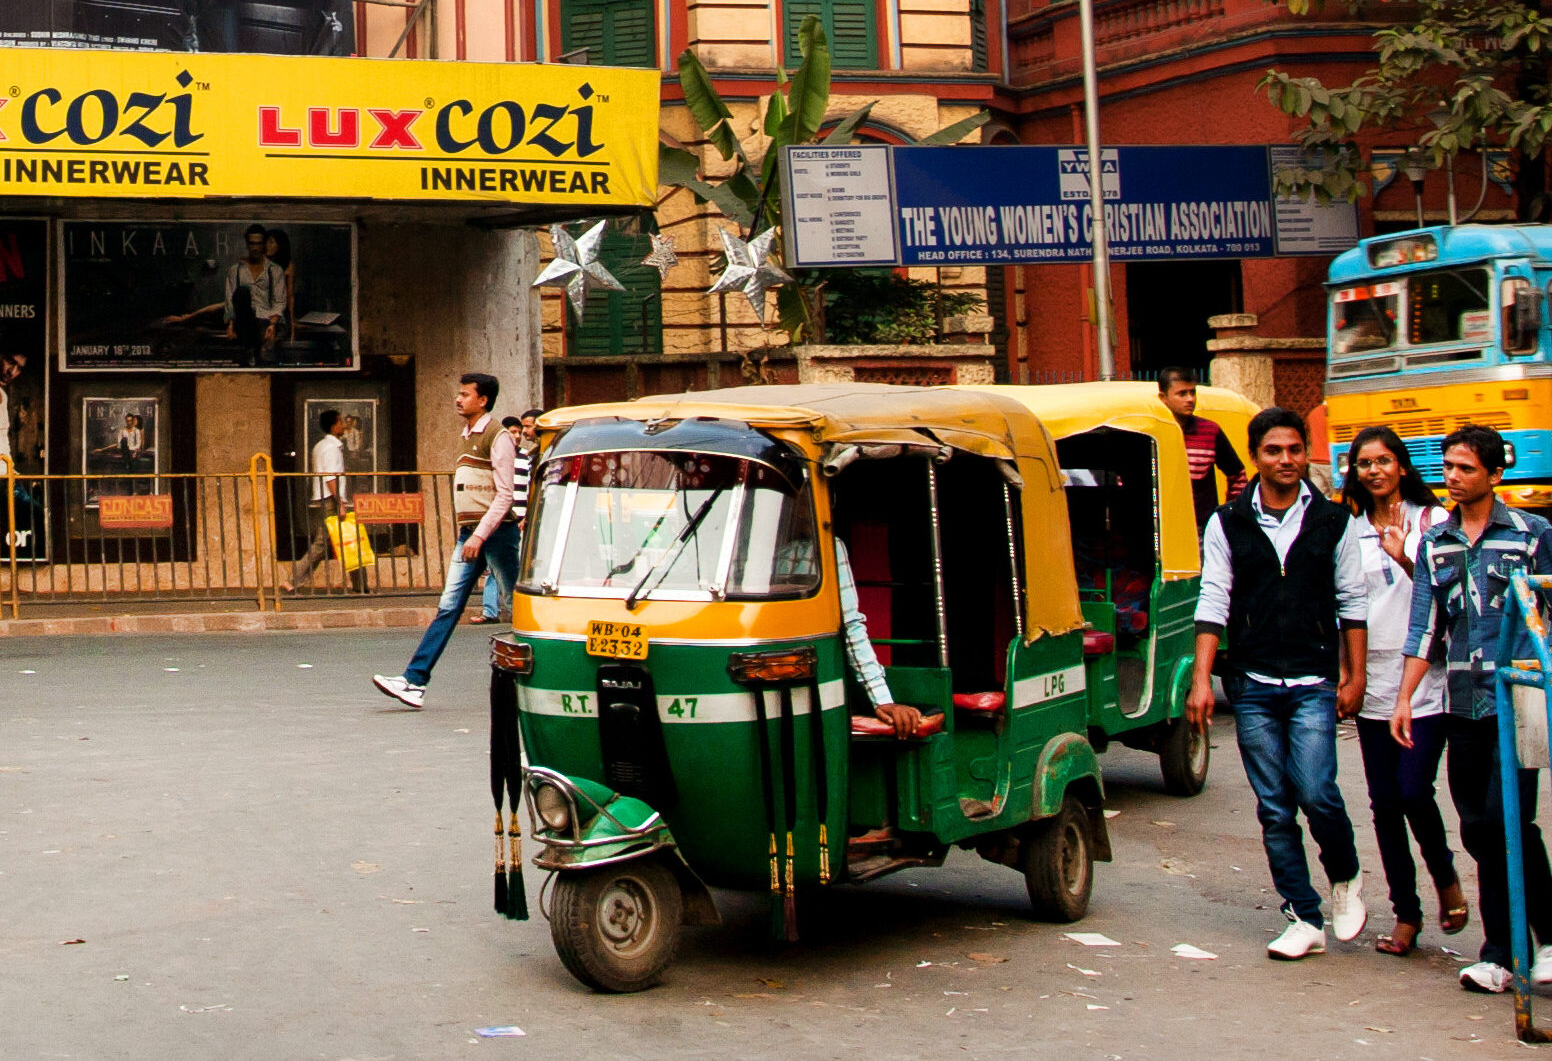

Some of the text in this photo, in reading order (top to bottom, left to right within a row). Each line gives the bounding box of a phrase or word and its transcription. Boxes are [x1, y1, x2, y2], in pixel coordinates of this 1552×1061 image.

[4, 158, 210, 186] INNERWEAR
[1062, 161, 1115, 173] YWA
[420, 167, 611, 195] INNERWEAR
[901, 207, 937, 246] THE
[938, 206, 997, 246] YOUNG
[1000, 204, 1079, 245] WOMEN'S
[1083, 202, 1167, 243] CRISTIAN
[1170, 200, 1271, 240] ASSOCIATION
[68, 230, 229, 256] INKAAR
[918, 251, 945, 260] HEAD
[948, 250, 982, 260] OFFICE
[1014, 248, 1065, 258] SURENDRA
[1176, 244, 1218, 254] KOLKATA
[70, 345, 110, 356] JANUARY
[102, 498, 171, 516] CONCAST
[355, 497, 421, 514] CONCAST
[561, 693, 698, 718] R.T. 47
